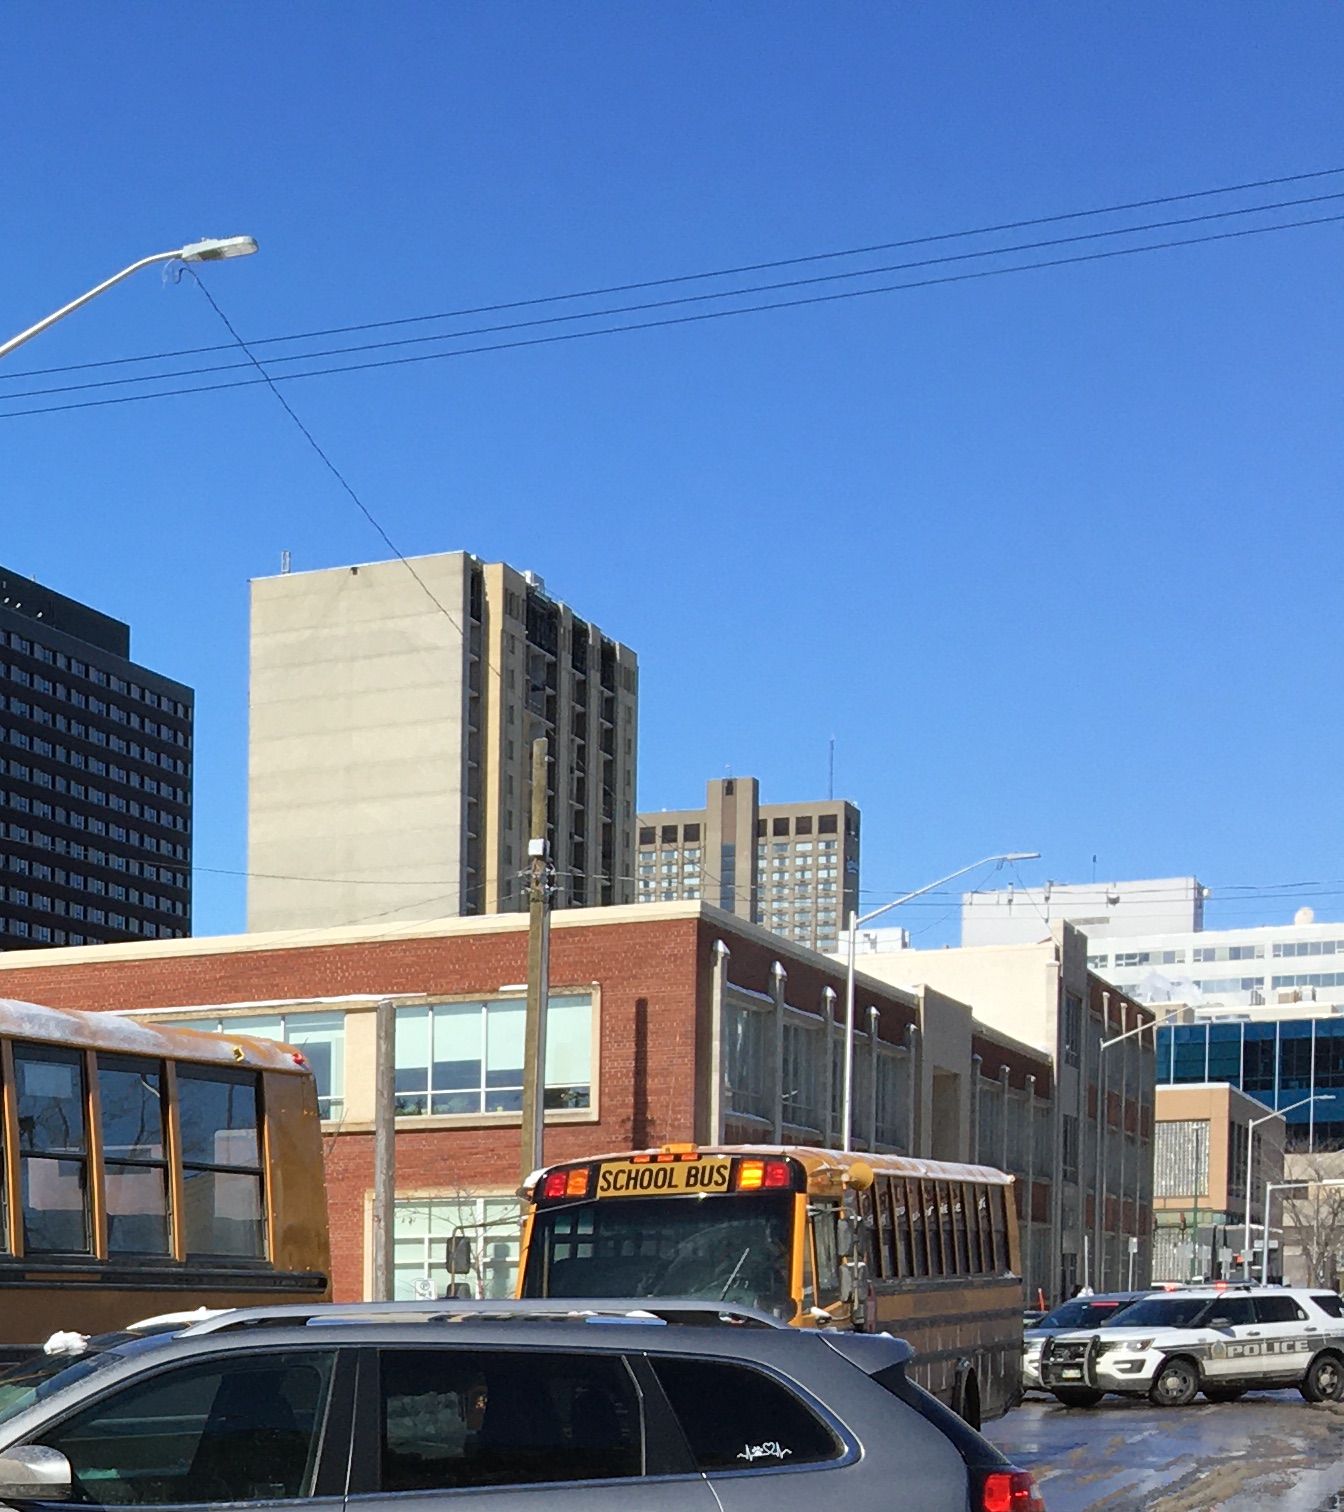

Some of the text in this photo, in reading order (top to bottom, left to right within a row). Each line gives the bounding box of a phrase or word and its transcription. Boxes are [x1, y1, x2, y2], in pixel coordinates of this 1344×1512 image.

[600, 1164, 728, 1192] SCHOOL BUS
[1227, 1340, 1310, 1357] POLICE
